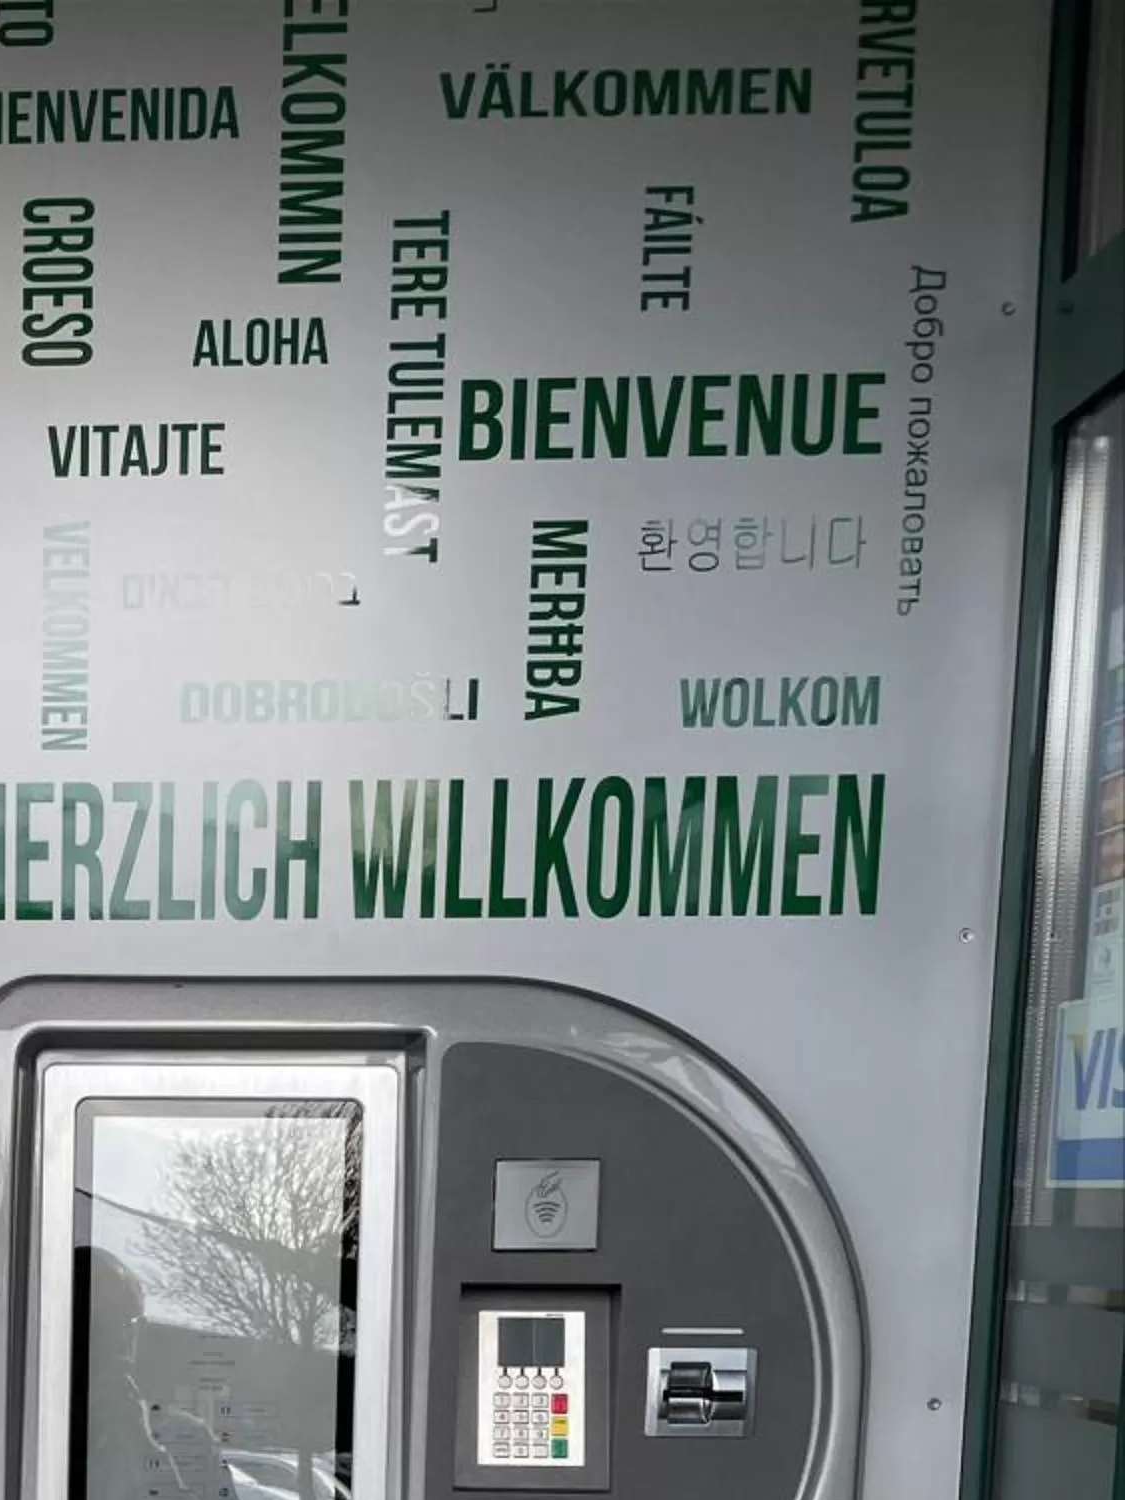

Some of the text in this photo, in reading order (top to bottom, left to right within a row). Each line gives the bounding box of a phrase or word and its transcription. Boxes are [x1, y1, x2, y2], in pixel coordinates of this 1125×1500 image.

[440, 63, 812, 119] VÄLKOMMEN
[22, 197, 96, 367] CROESO
[640, 185, 704, 311] FÁILTE
[192, 316, 329, 367] ALOHA
[383, 209, 451, 563] TERE TULEMAST
[47, 422, 226, 478] VITAJTE
[458, 371, 887, 461] BIENVENUE
[897, 265, 947, 617] Добро пожаловать
[638, 516, 867, 573] 환영합니다
[41, 521, 91, 751] VELKOMMEN
[680, 676, 881, 728] WOLKOM
[348, 773, 885, 920] WILLKOMMEN
[1068, 1027, 1125, 1110] VI
